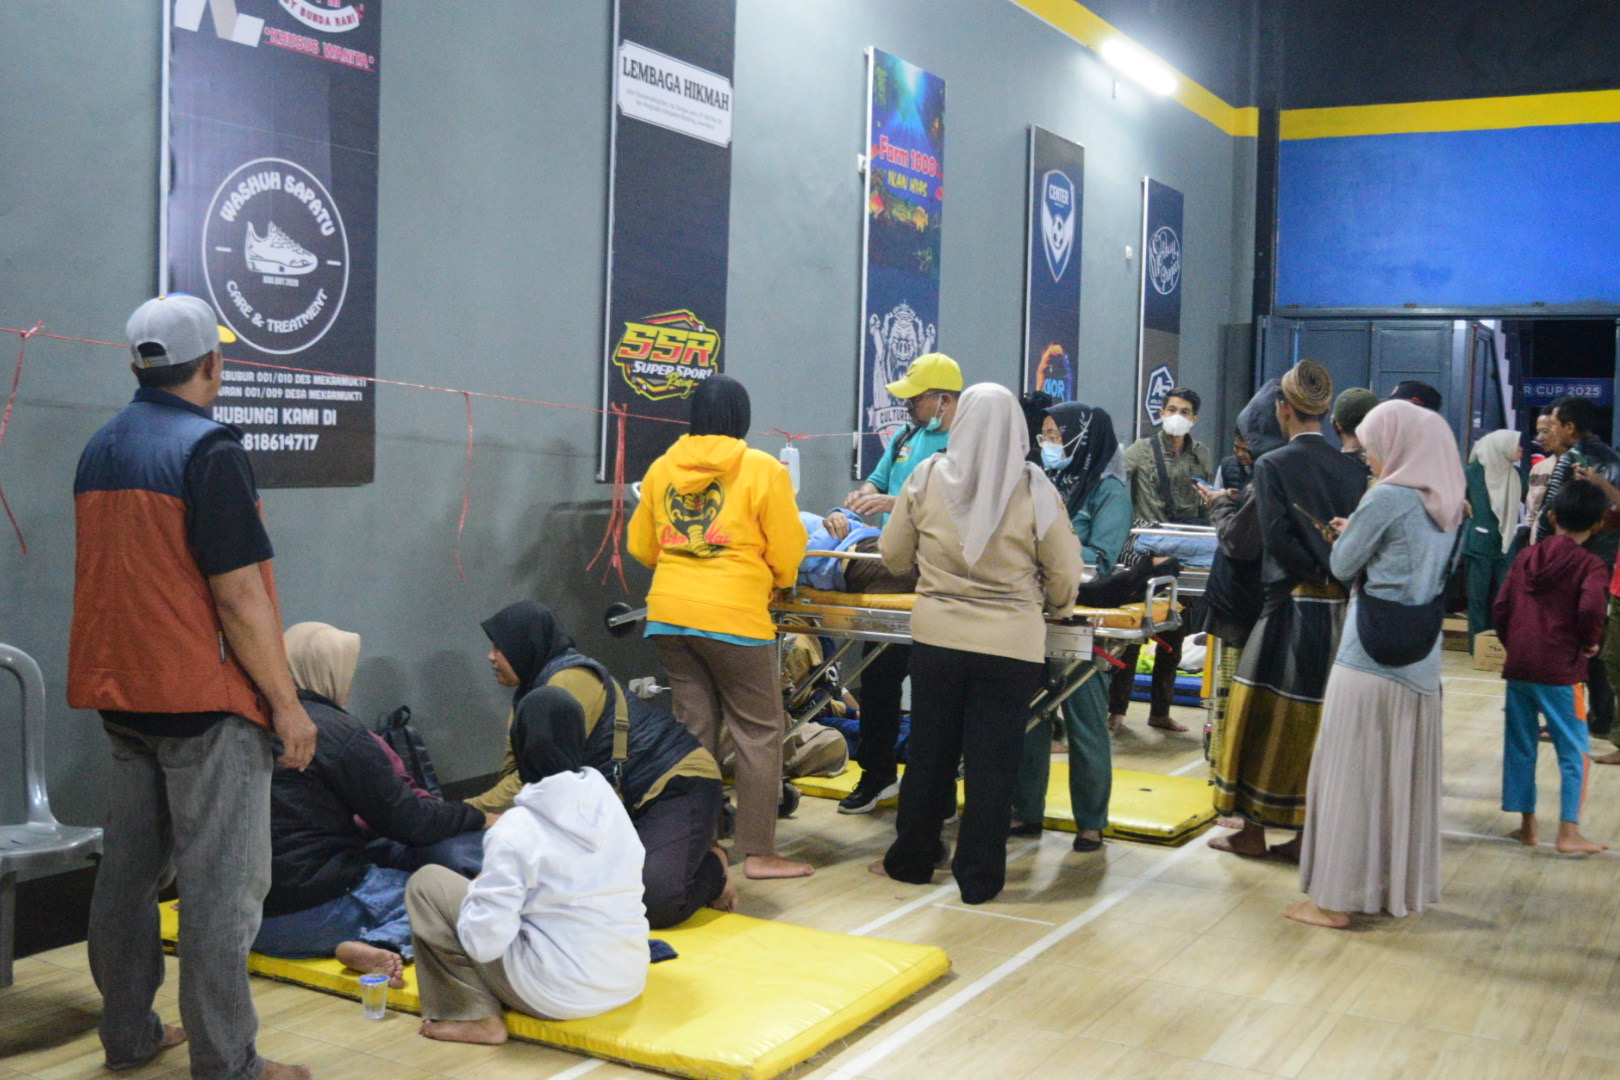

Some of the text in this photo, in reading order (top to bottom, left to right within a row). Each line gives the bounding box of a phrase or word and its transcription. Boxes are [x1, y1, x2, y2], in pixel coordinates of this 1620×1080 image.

[300, 7, 331, 26] BUNDA
[623, 56, 681, 95] LEMBAGA
[684, 78, 730, 112] HIKMAH
[879, 135, 937, 177] Farm 1000
[226, 280, 328, 333] CARE & TREATMENT
[617, 322, 717, 367] SSR
[632, 361, 675, 377] SUPER
[1536, 386, 1563, 395] CUP
[1567, 385, 1600, 397] 2025
[213, 406, 337, 426] HUBUNGI KAMI DI
[241, 433, 319, 451] 818614717
